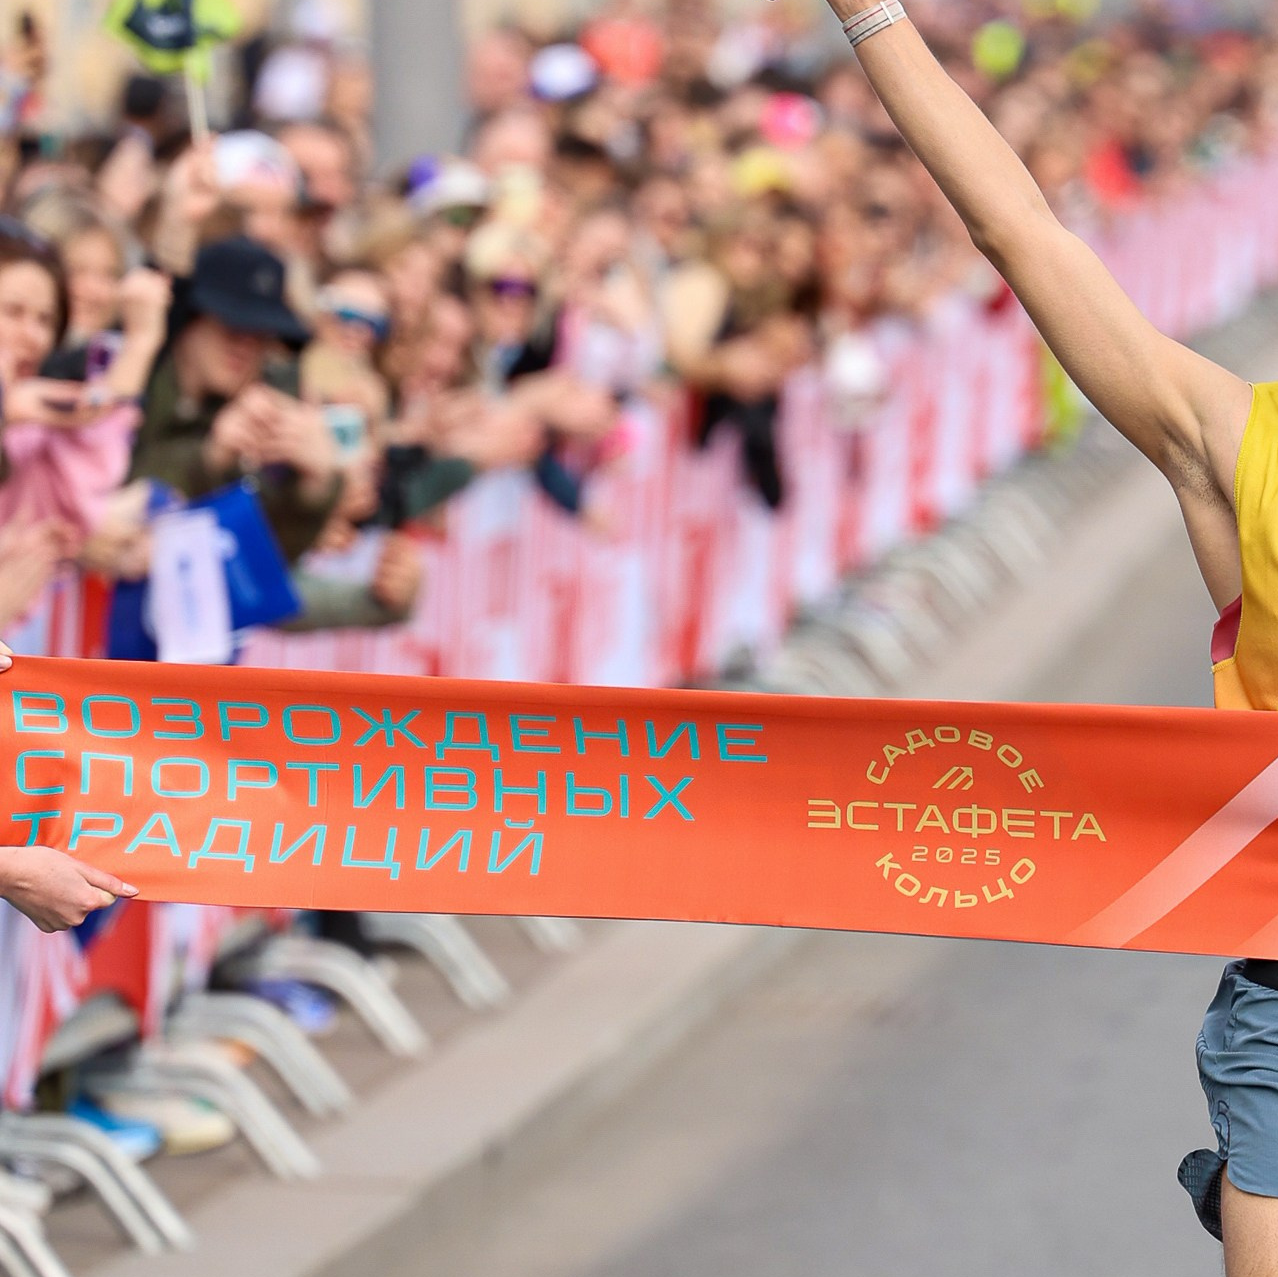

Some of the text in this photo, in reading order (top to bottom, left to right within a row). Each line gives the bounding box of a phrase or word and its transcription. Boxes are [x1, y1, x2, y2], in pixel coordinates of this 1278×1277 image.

[12, 691, 768, 764] ВОЗРОЖДЕНИЕ
[866, 725, 1045, 794] САДОВОЕ
[15, 750, 696, 822] СПОРТИВНЫХ
[807, 798, 1107, 842] ЭСТАФЕТА
[11, 810, 544, 880] ТРАДИЦИЙ
[911, 844, 1001, 866] 2025
[875, 851, 1037, 910] КОЛЬЦО
